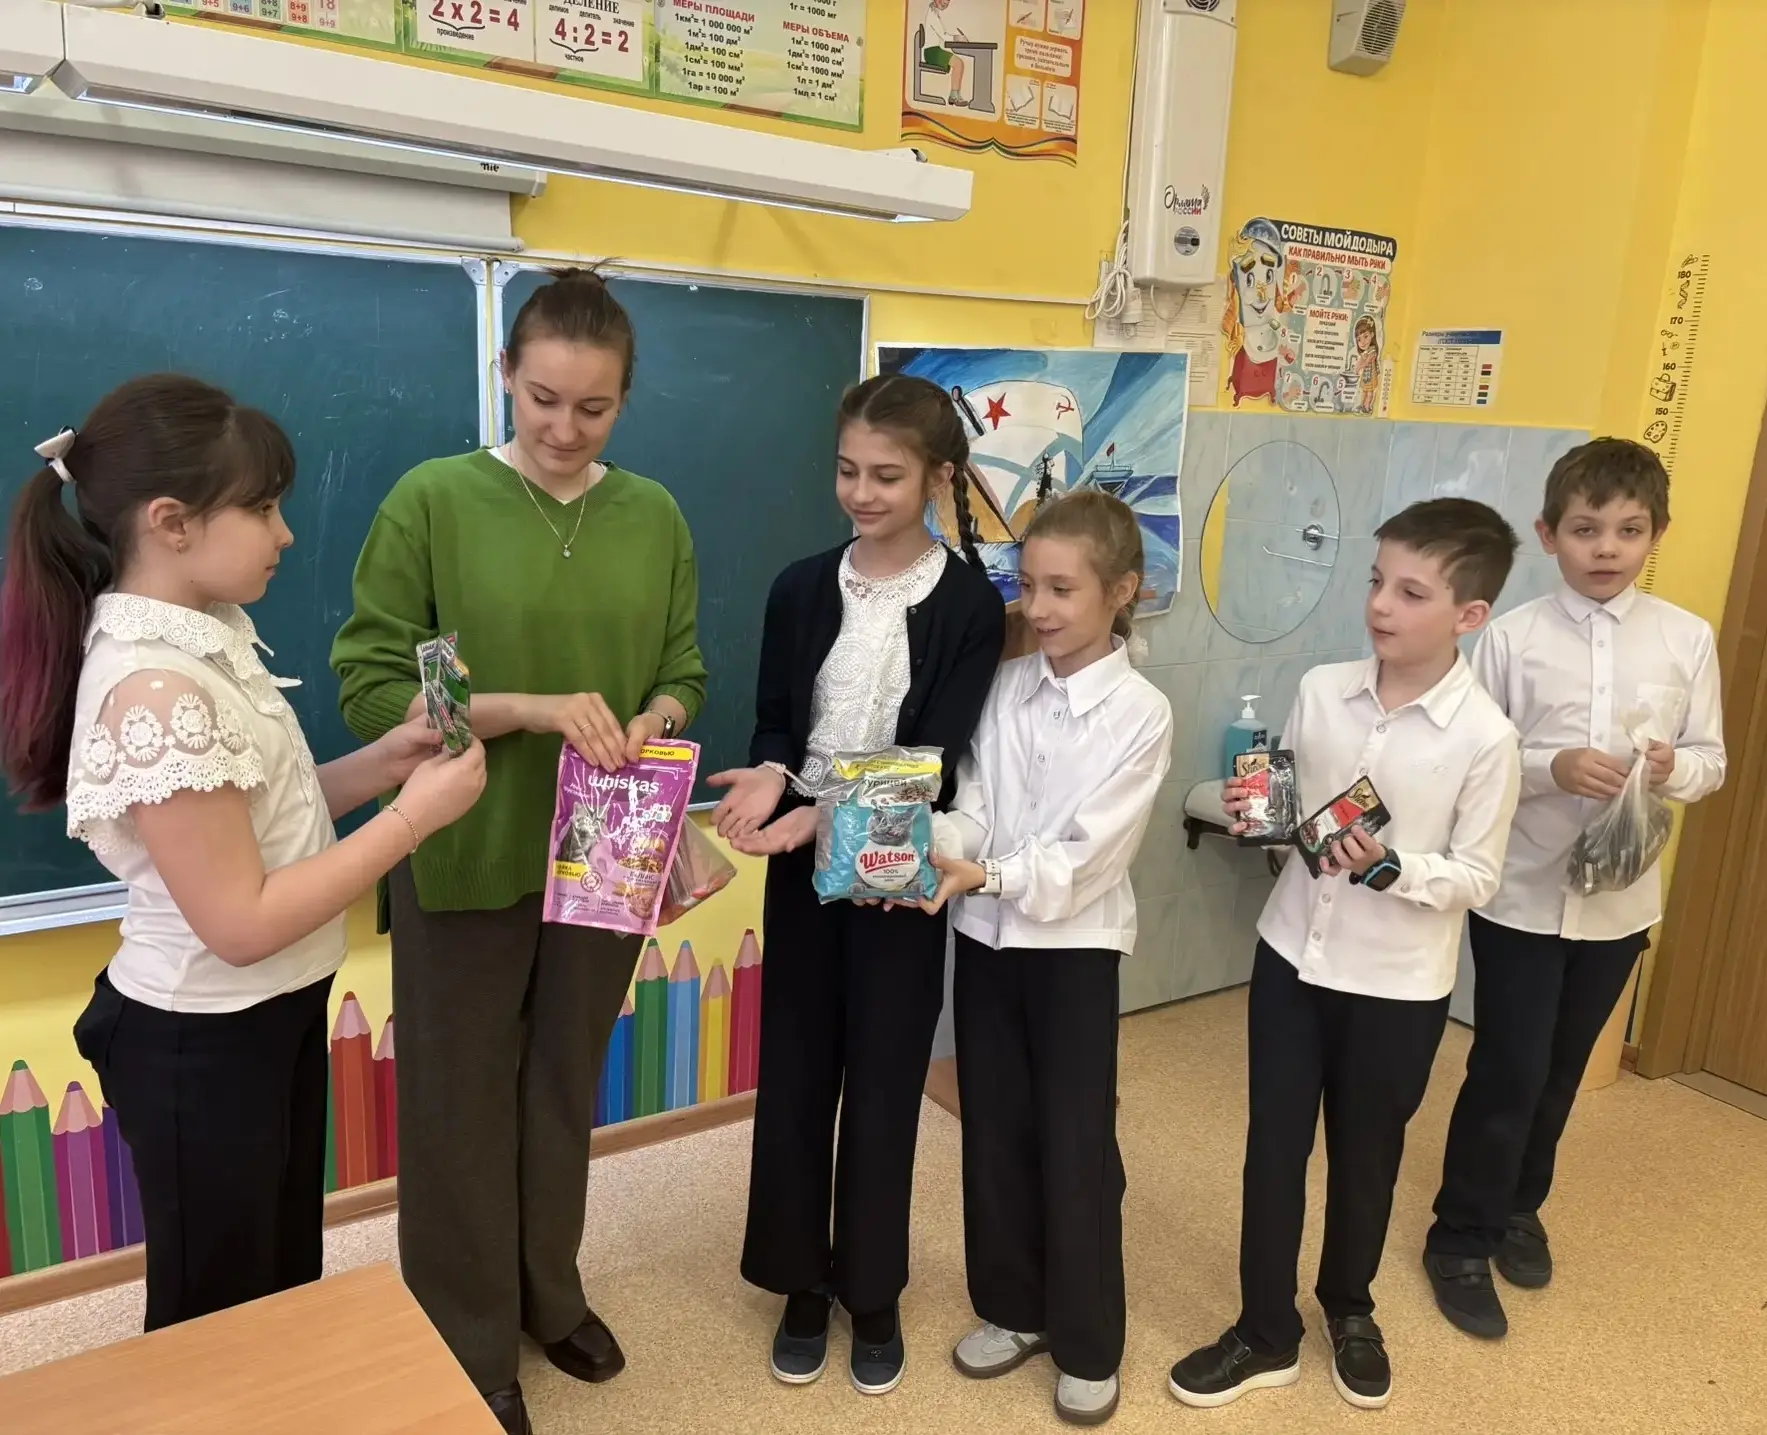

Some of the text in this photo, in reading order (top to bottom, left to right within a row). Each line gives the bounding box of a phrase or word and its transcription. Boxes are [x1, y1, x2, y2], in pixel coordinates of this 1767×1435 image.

[232, 4, 250, 13] 9+6
[261, 8, 279, 18] 9+7
[673, 0, 755, 22] МЕРЫ ПЛОЩАДИ
[291, 12, 308, 23] 9+8
[470, 0, 483, 24] 2
[507, 8, 520, 31] 4
[319, 18, 336, 28] 9+9
[555, 17, 567, 41] 4
[584, 23, 596, 46] 2
[618, 30, 629, 53] 2
[783, 21, 850, 43] МЕРЫ ОБЪЕМА
[1281, 224, 1394, 256] СОВЕТЫ МОЙДОДЫРА
[1288, 246, 1386, 270] КАК ПРАВИЛЬНО МЫТЬ РУКИ
[1677, 271, 1691, 279] 180
[1309, 309, 1331, 320] МОЙТЕ
[1669, 316, 1684, 325] 170
[1662, 363, 1676, 371] 160
[1655, 407, 1669, 416] 150
[640, 748, 675, 756] ОРКОВЬЮ
[588, 774, 659, 793] whiskas
[860, 850, 915, 869] Watson
